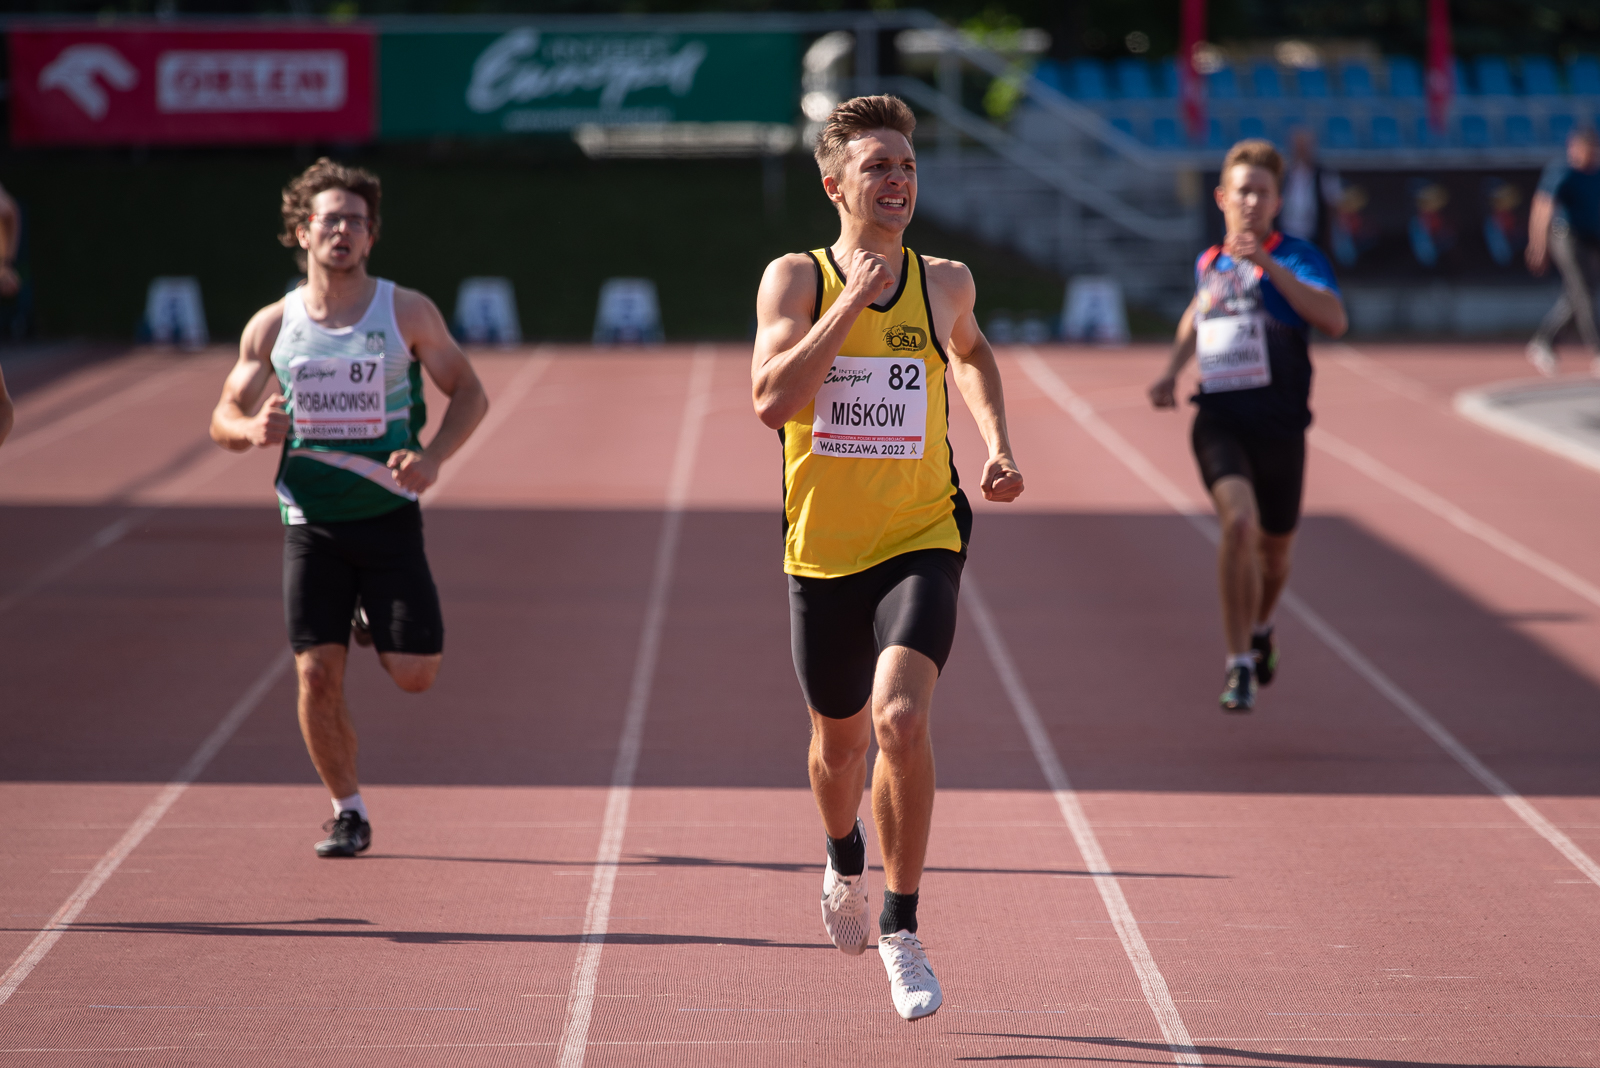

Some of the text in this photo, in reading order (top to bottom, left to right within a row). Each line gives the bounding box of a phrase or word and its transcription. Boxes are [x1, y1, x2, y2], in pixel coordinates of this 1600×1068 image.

[890, 334, 918, 348] OSA
[349, 362, 378, 383] 87
[888, 363, 920, 390] 82
[296, 391, 381, 412] ROBAKOWSKI
[831, 396, 906, 427] MIŚKÓW
[819, 440, 905, 455] WARSZAWA 2022
